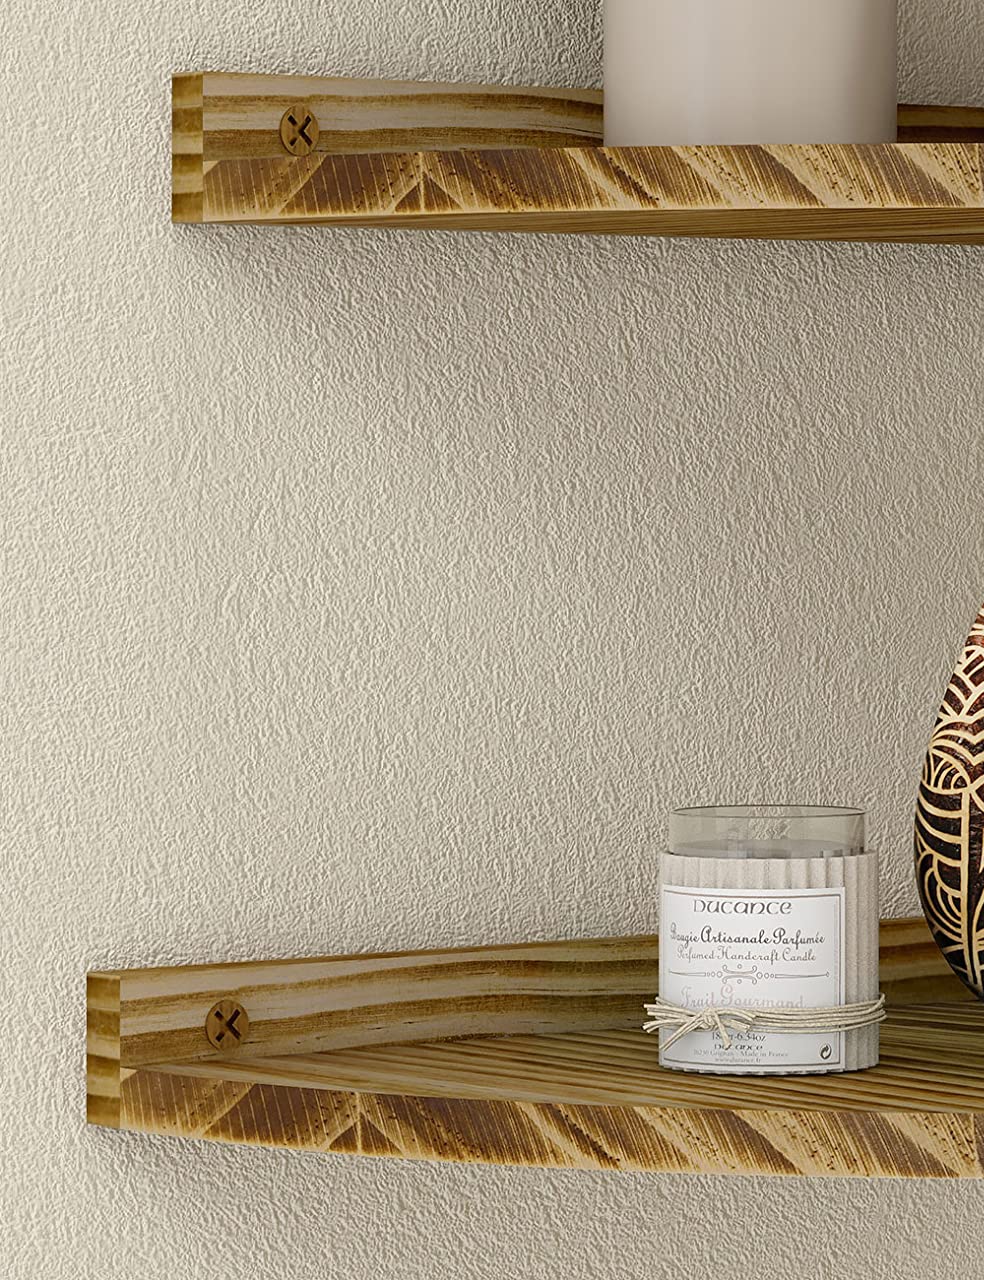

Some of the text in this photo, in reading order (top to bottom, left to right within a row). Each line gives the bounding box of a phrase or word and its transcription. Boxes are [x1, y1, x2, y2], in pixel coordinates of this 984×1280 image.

[700, 925, 773, 945] Artisanale
[773, 927, 825, 950] Parfumée
[677, 945, 817, 965] Perfumed Handcraft Candle
